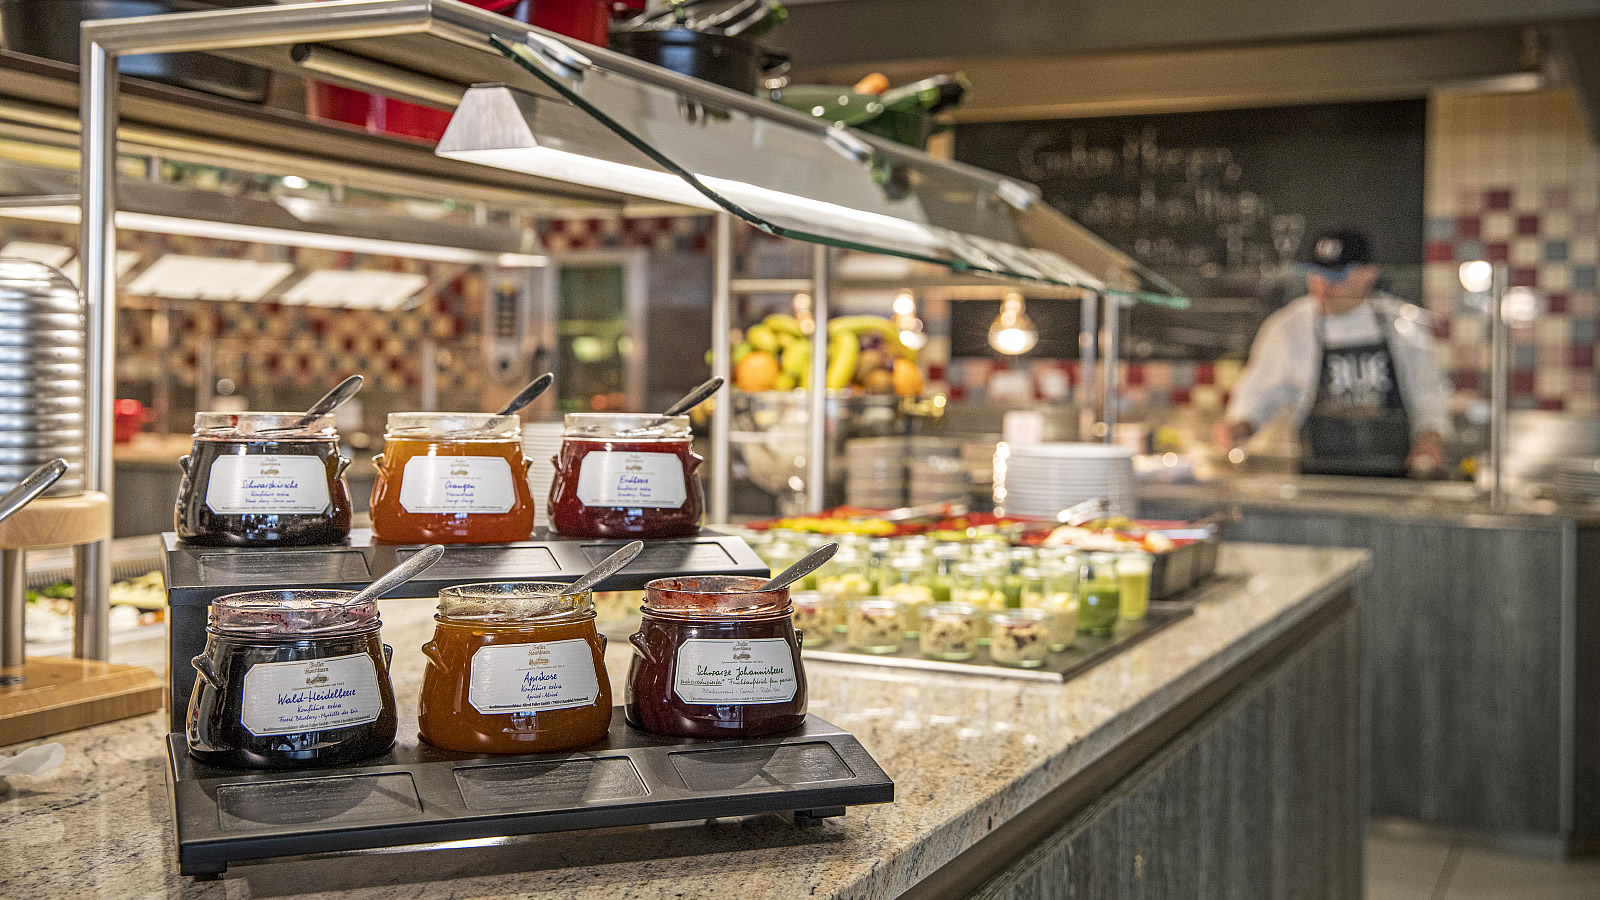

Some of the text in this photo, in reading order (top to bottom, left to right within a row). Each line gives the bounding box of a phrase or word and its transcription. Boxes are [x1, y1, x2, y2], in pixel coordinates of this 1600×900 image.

[696, 665, 732, 676] Schwarze
[524, 671, 558, 686] Aprikose
[278, 688, 356, 705] Wald-Heidelbeere
